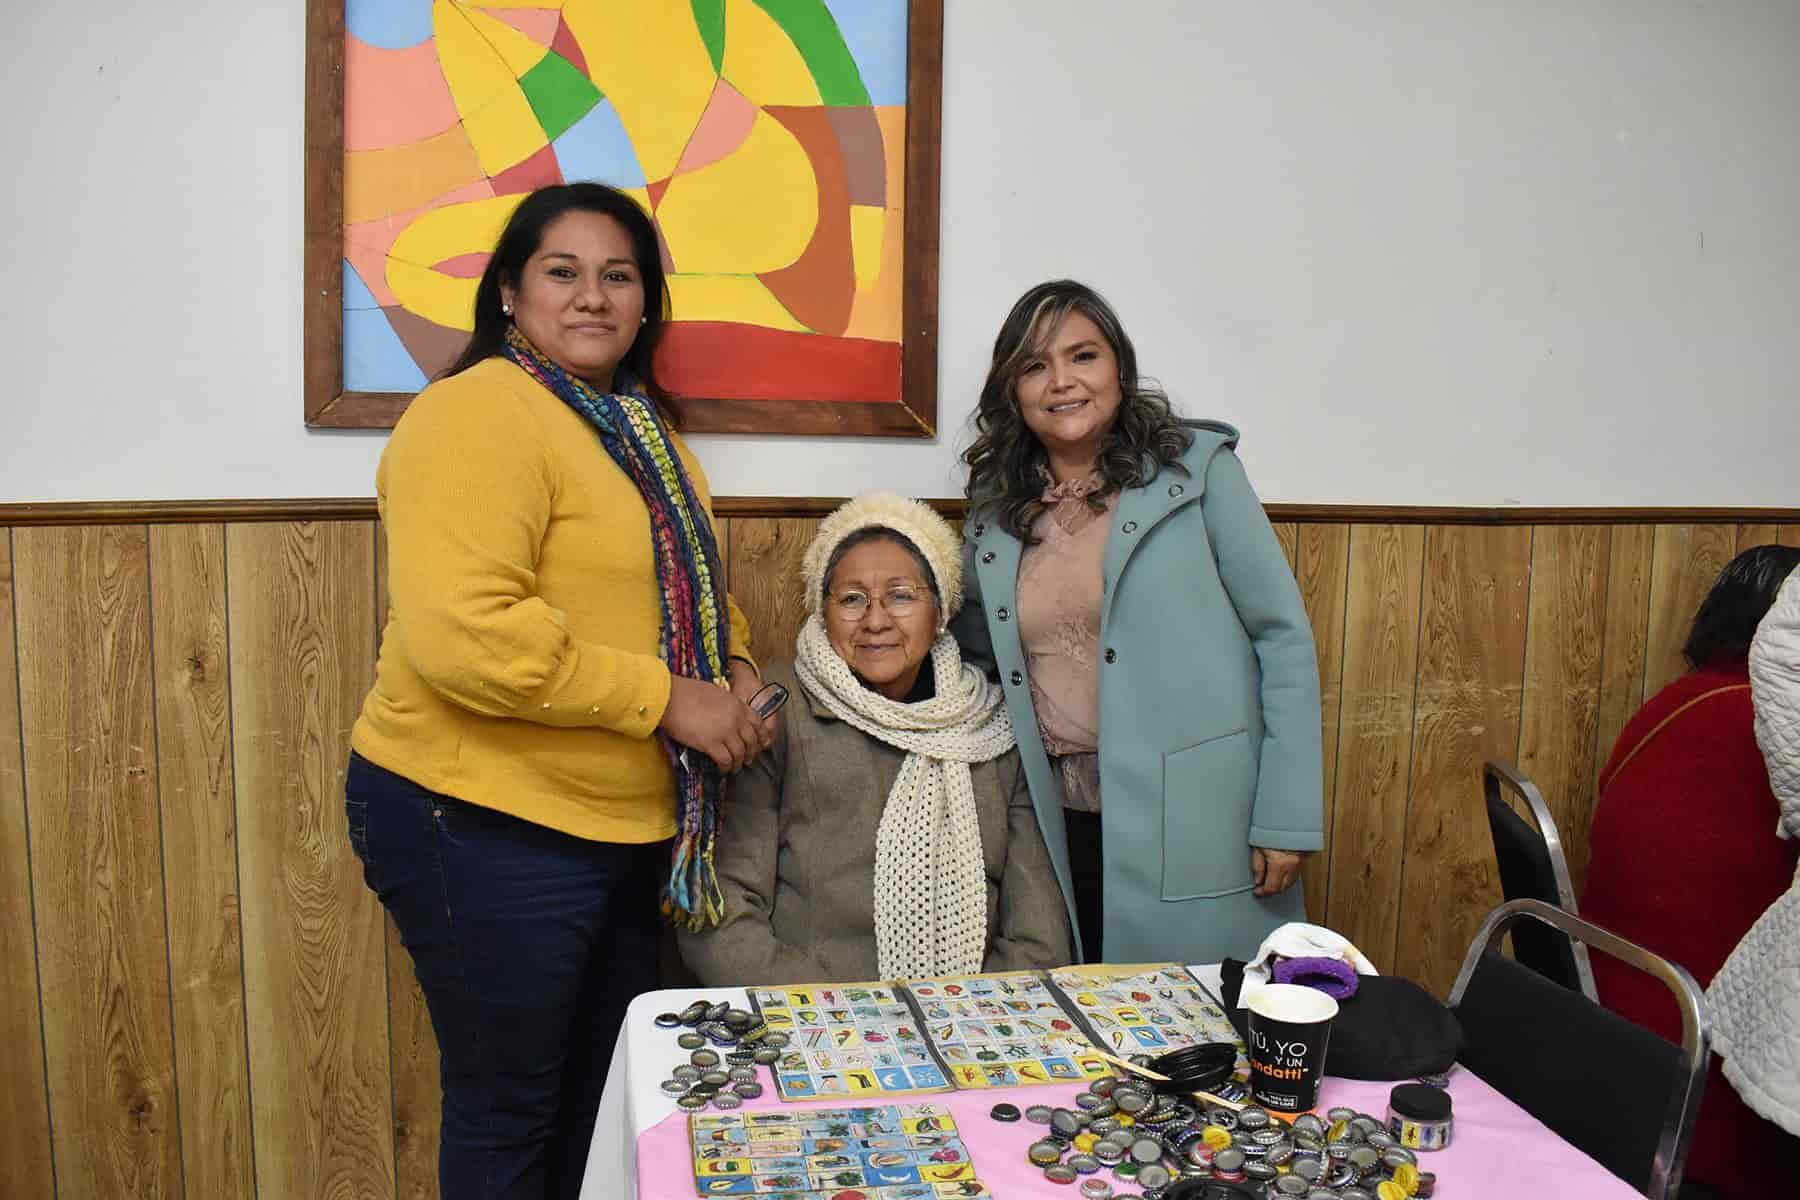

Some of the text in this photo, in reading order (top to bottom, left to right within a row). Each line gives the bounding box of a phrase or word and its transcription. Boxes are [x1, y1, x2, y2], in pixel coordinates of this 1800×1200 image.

[1275, 1040, 1307, 1057] YO
[1275, 1055, 1303, 1067] Y UN
